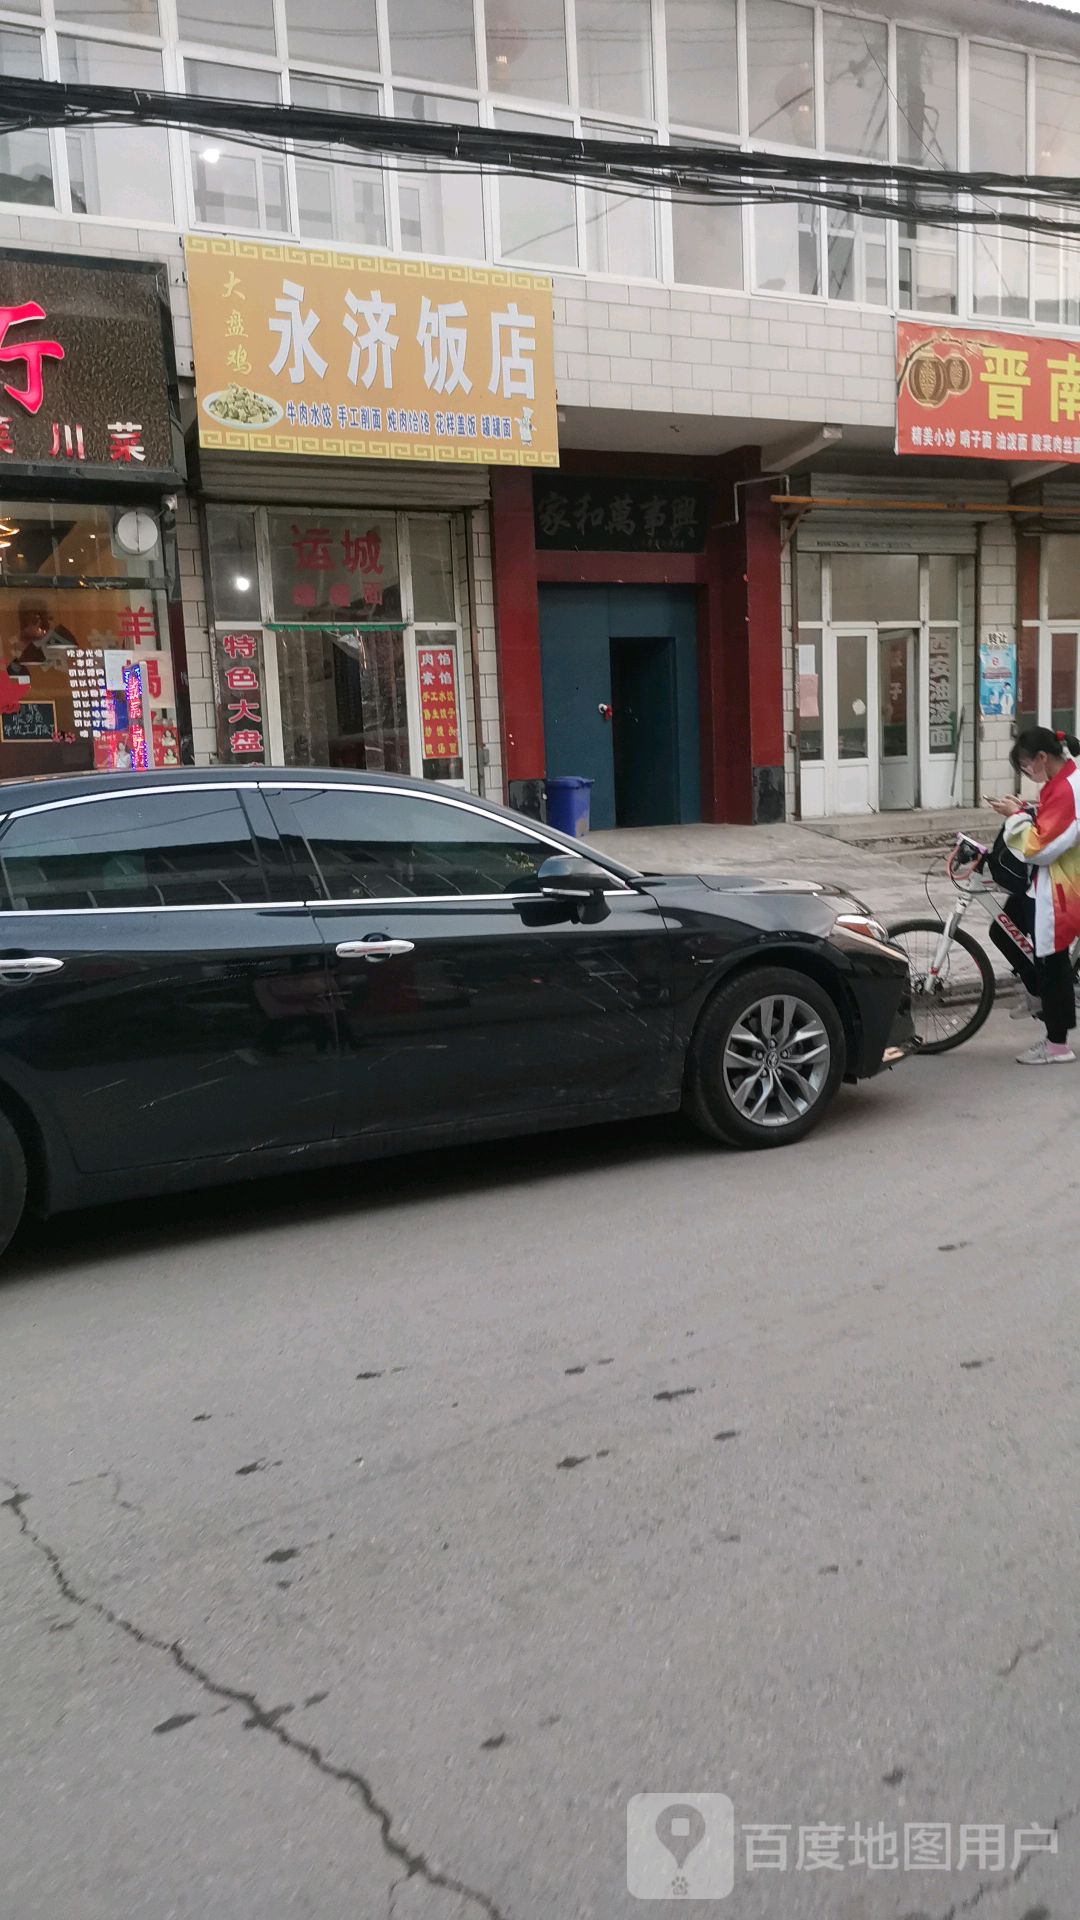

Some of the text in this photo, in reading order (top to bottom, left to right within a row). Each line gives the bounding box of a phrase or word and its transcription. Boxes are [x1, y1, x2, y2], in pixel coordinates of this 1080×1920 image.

[222, 271, 252, 376] 大盘鸡
[268, 278, 536, 400] 永济饭店
[286, 400, 332, 429] 牛肉水饺
[337, 404, 382, 432] 手工削面
[435, 411, 477, 438] 花样盖饭
[481, 414, 512, 440] 罐罐面
[980, 347, 1080, 423] 晋南
[911, 425, 956, 448] 精美小炒
[996, 432, 1028, 452] 油泼面
[290, 524, 384, 575] 运城
[223, 633, 266, 766] 特色大盘
